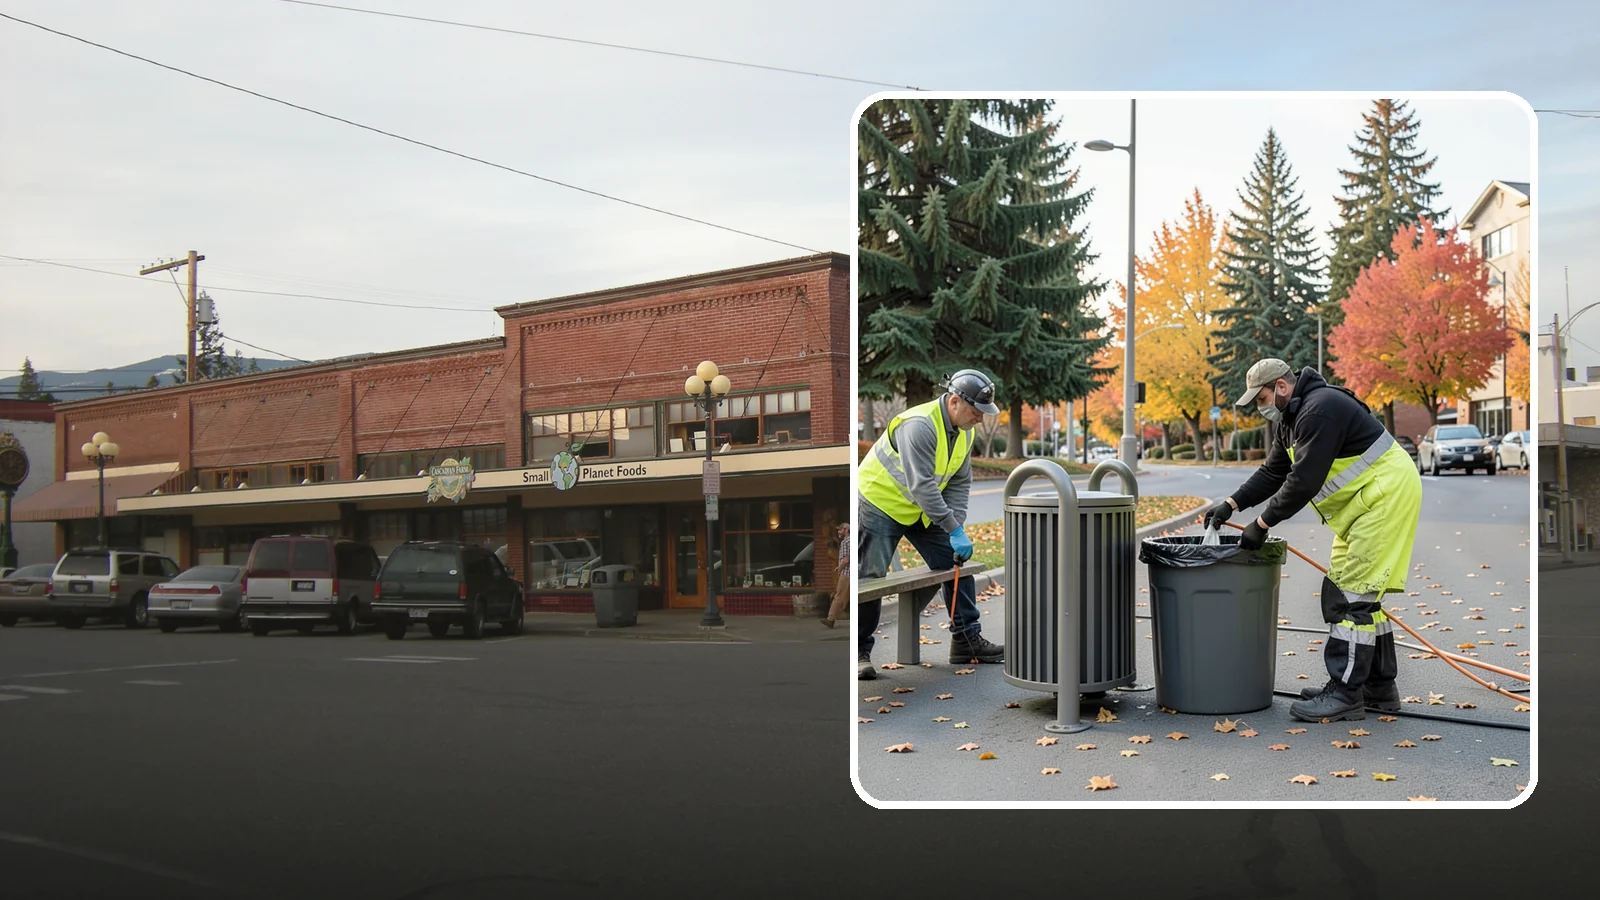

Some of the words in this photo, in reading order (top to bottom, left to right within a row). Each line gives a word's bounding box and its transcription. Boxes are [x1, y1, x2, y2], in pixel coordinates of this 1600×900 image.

[455, 466, 469, 474] FARM
[523, 471, 549, 483] Small
[583, 467, 614, 479] Planet
[617, 464, 647, 477] Foods
